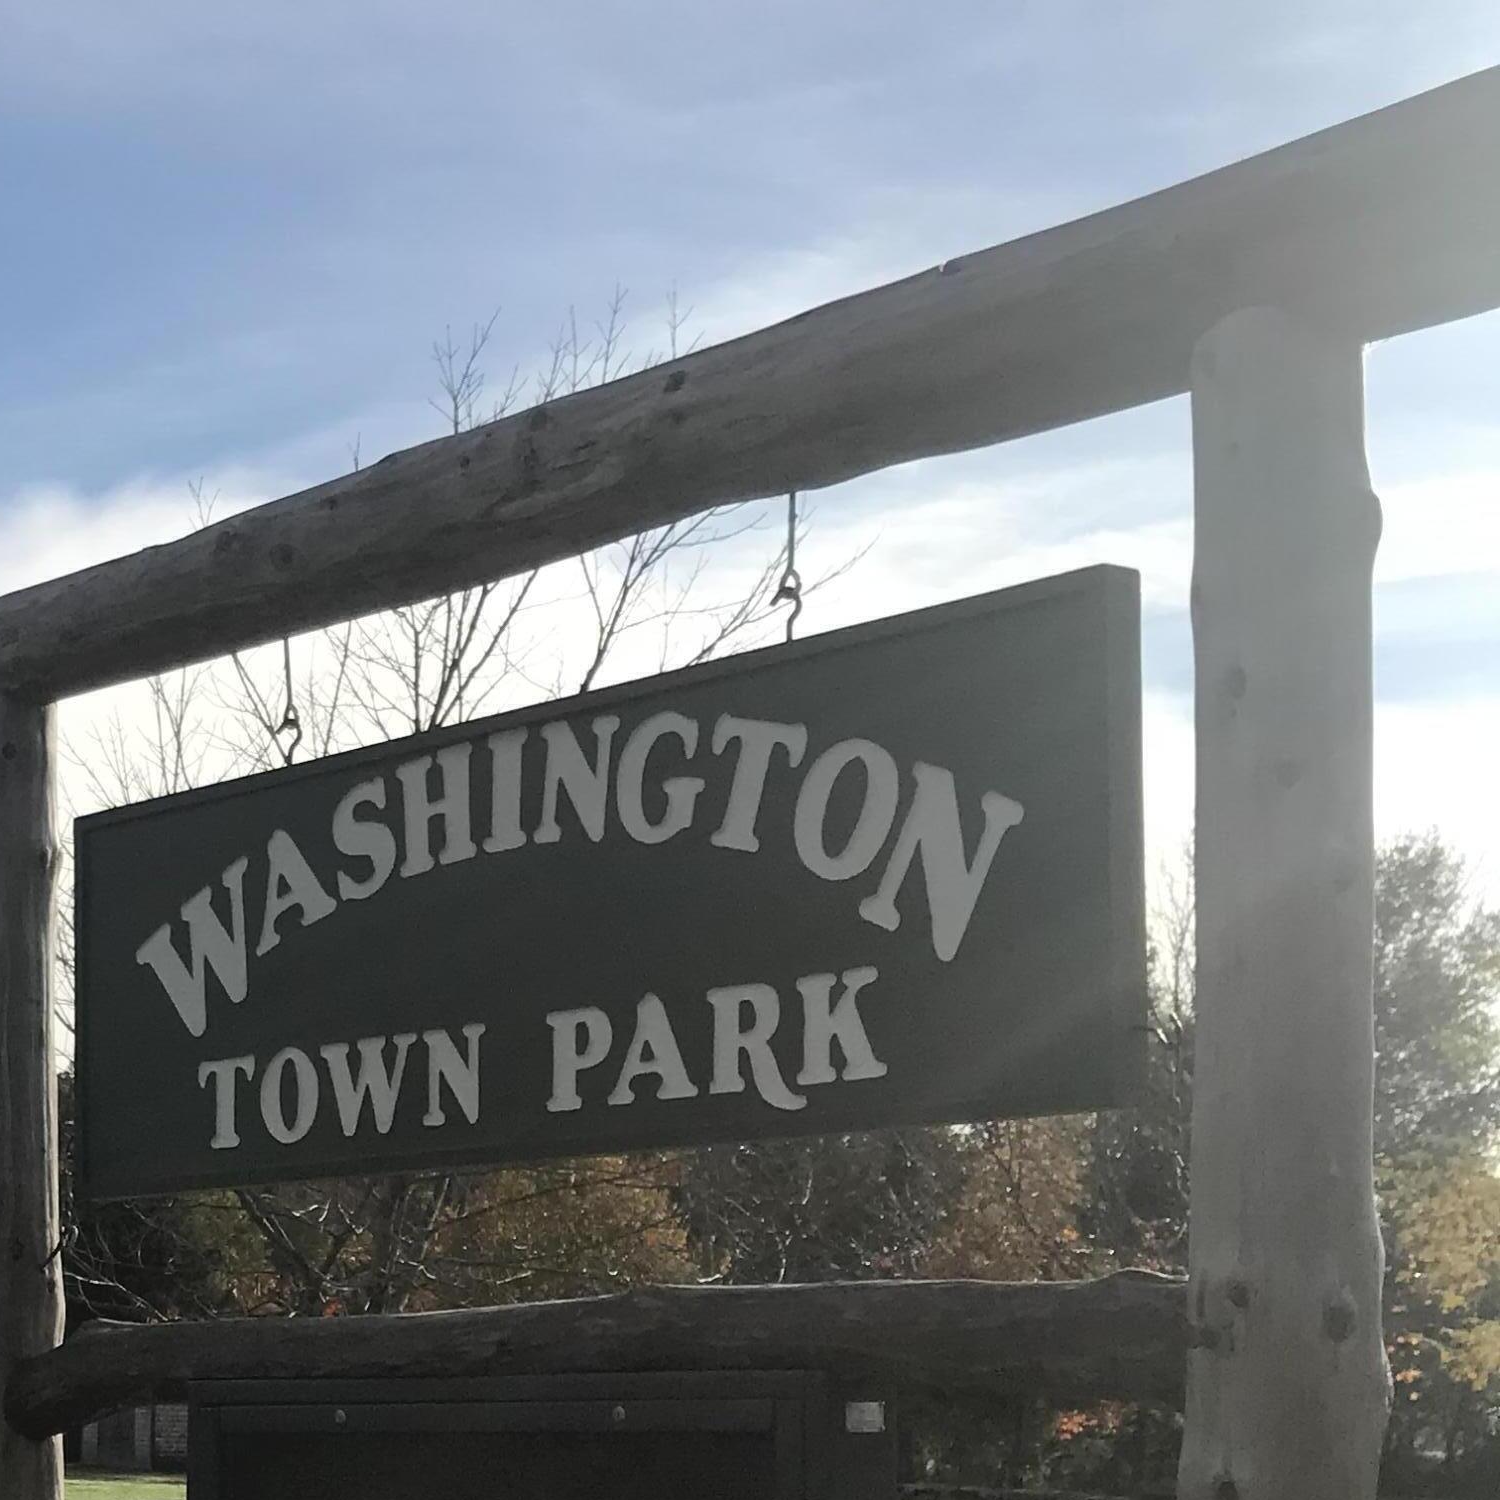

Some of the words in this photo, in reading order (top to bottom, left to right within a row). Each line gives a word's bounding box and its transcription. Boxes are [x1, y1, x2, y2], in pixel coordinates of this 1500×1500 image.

[136, 711, 1024, 1037] WASHINGTON
[198, 1023, 486, 1150] TOWN
[546, 966, 888, 1111] PARK
